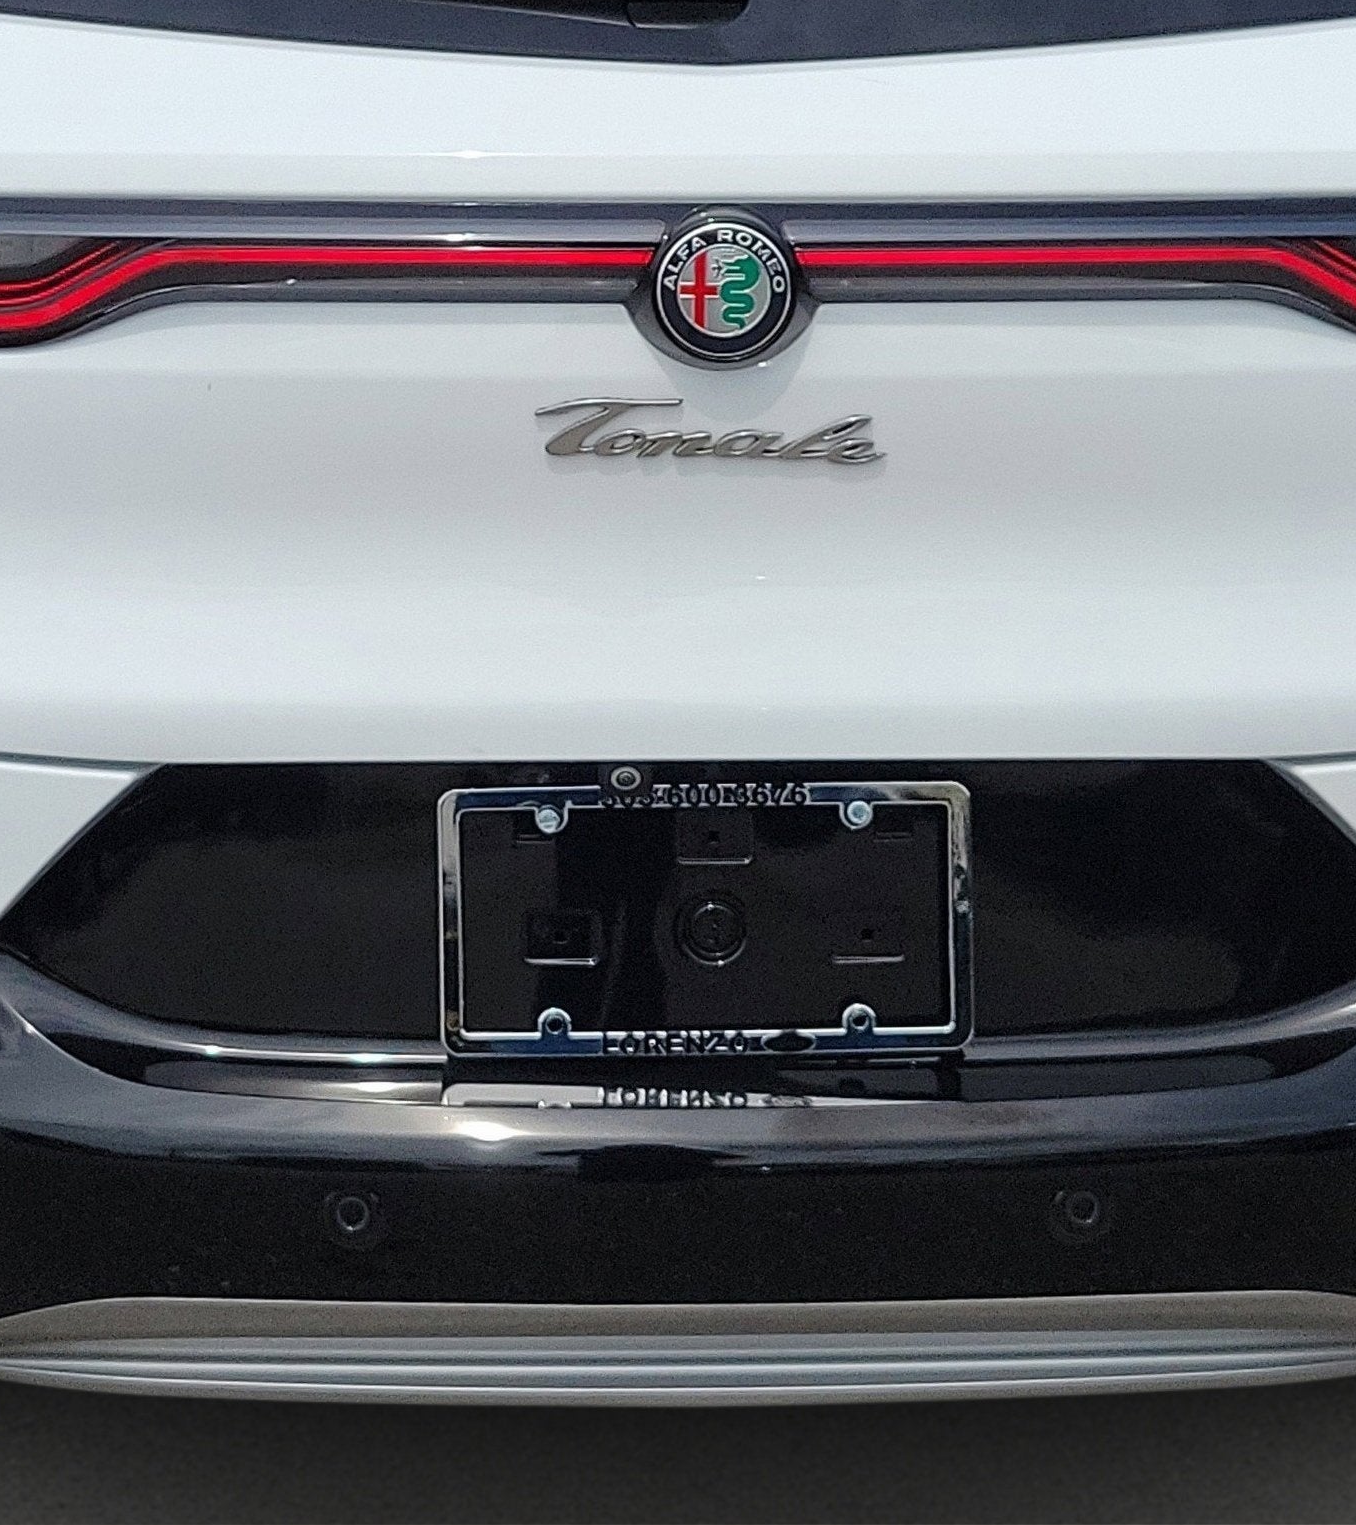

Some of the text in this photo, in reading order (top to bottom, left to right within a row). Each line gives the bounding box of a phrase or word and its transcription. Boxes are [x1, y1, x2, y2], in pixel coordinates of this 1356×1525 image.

[663, 229, 786, 294] ALFA ROMEO
[534, 397, 887, 464] Tonale
[602, 1029, 747, 1055] LORENZO
